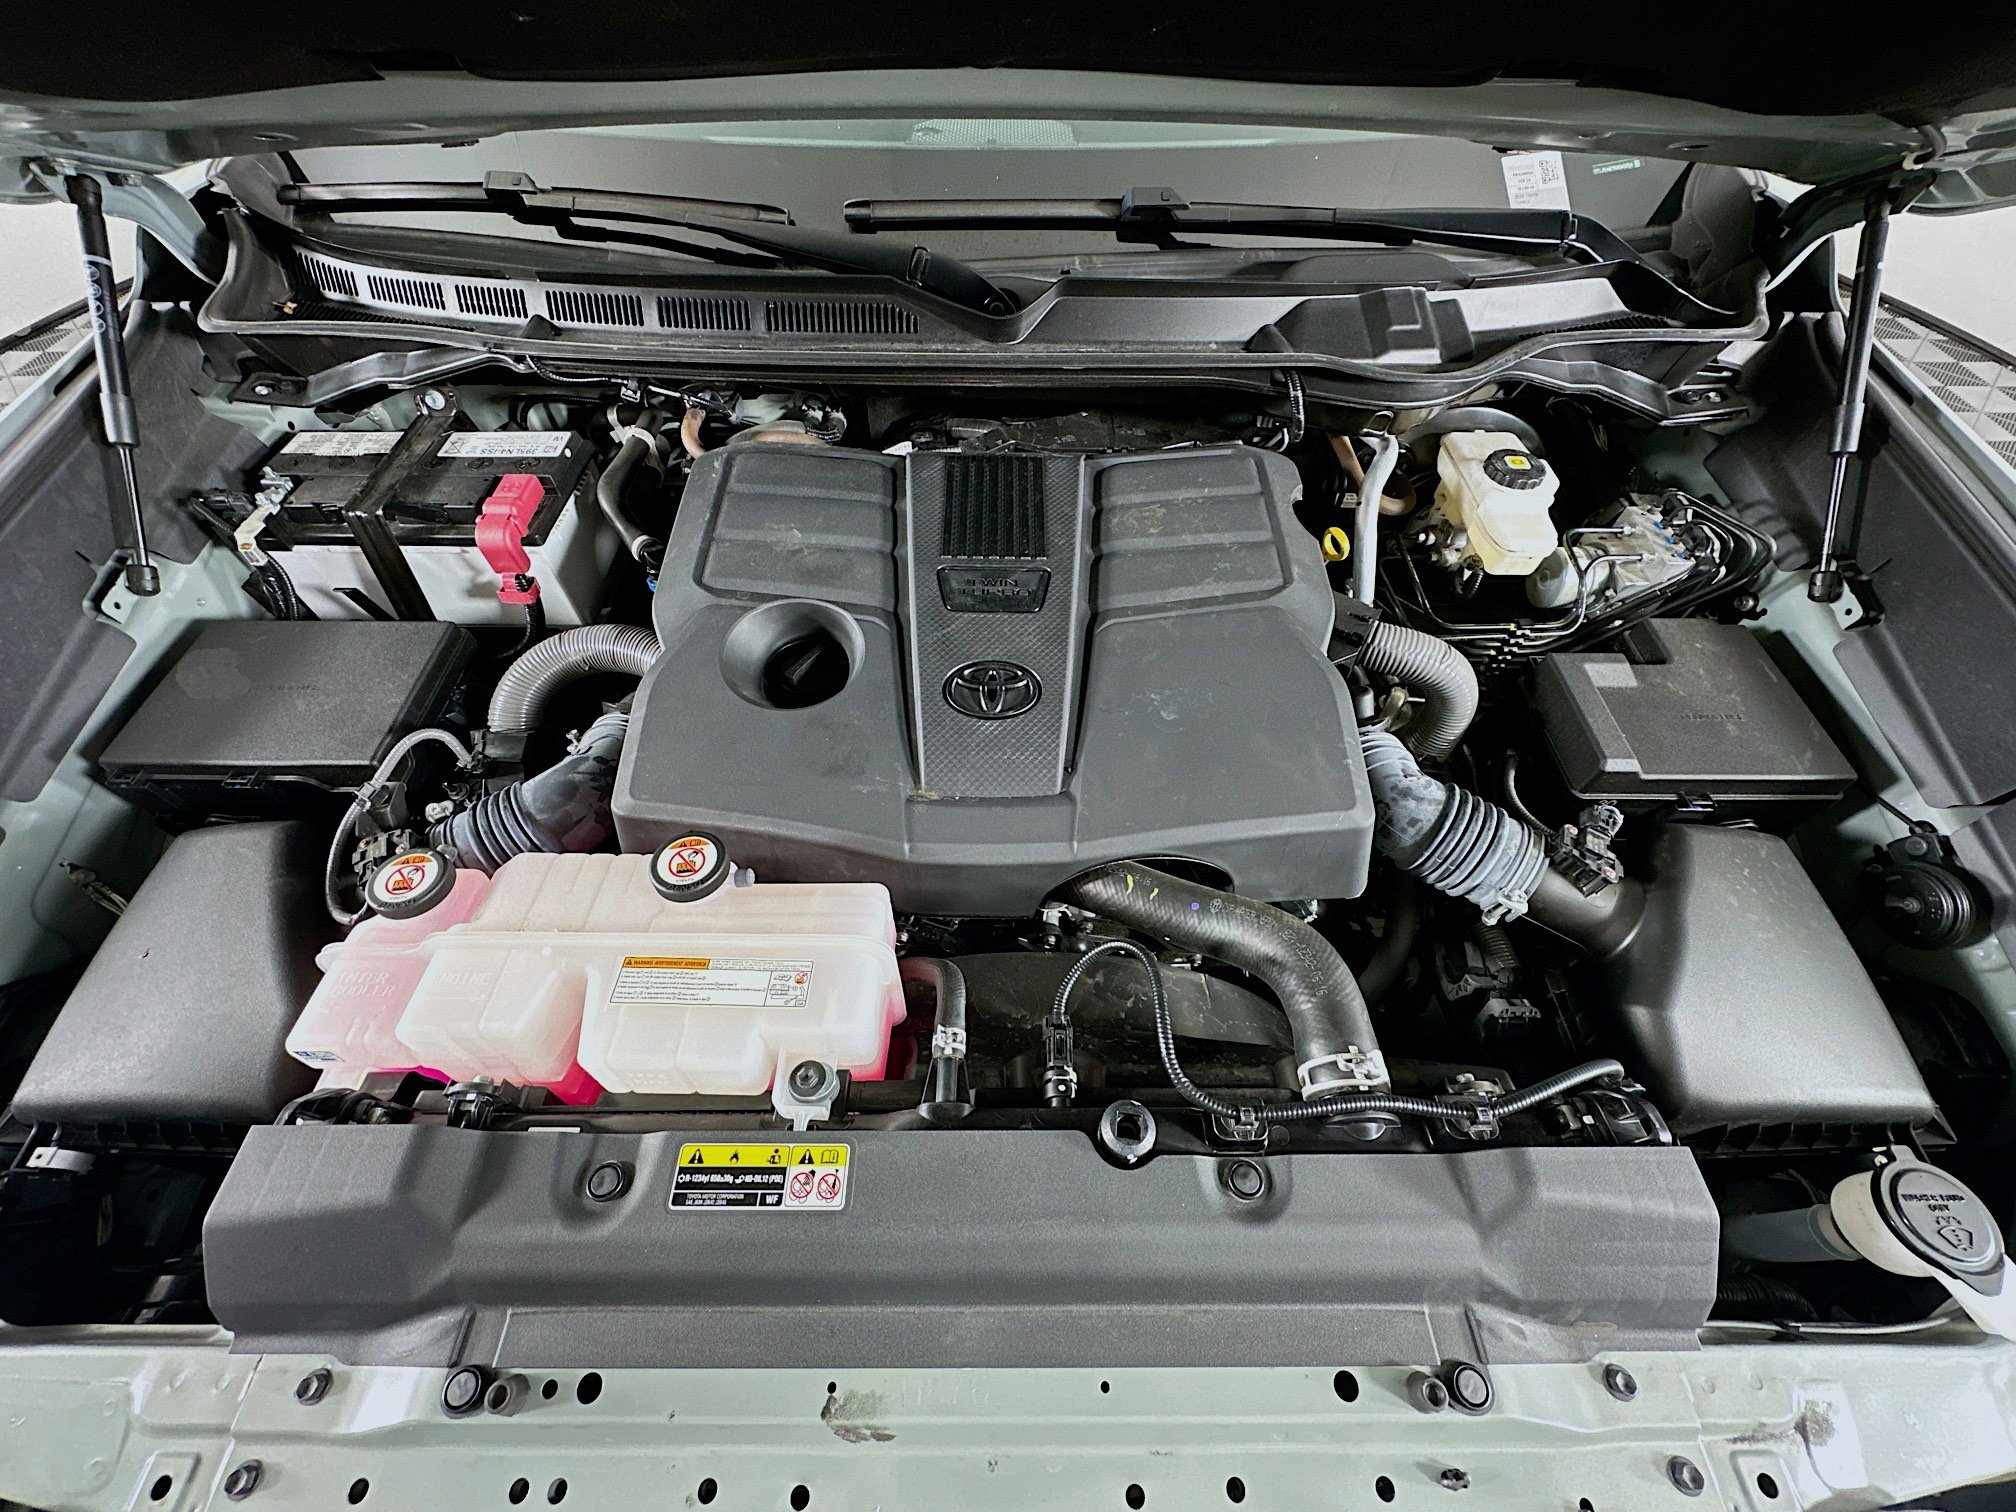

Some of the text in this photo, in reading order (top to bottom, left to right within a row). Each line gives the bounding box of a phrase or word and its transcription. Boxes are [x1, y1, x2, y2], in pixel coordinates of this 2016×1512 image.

[966, 578, 1018, 587] TWIN
[957, 587, 1032, 596] TURBO
[337, 972, 390, 984] INTER
[684, 1174, 710, 1184] R-1234yf
[768, 1174, 784, 1184] (POE)
[765, 1195, 779, 1204] WF
